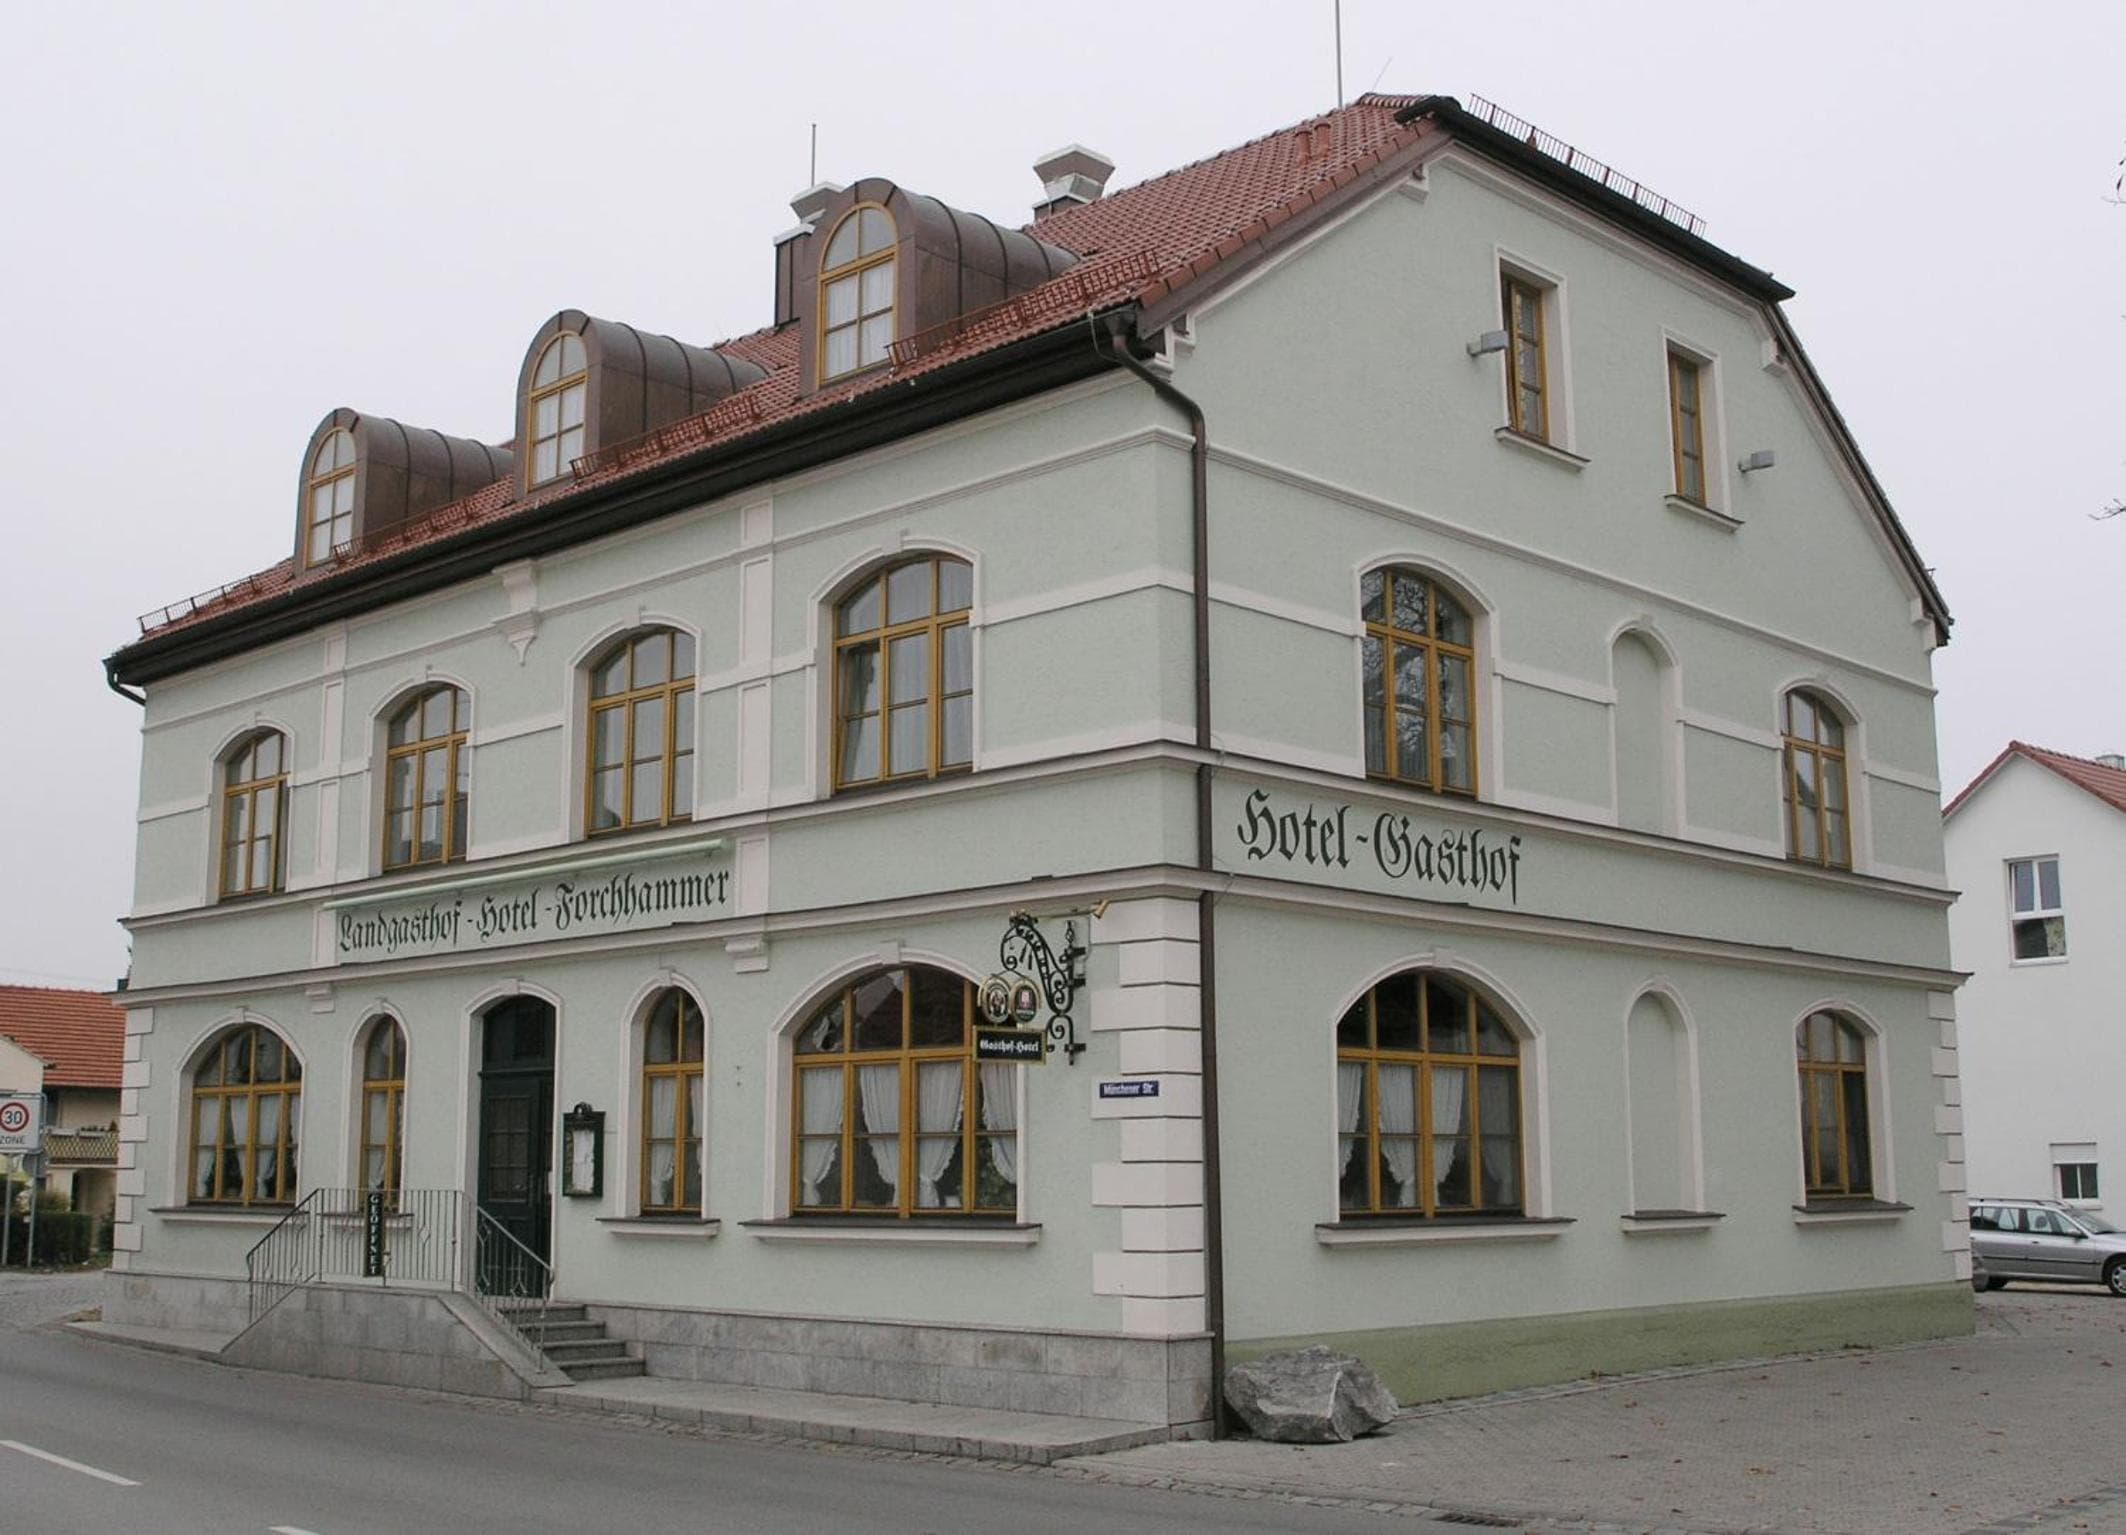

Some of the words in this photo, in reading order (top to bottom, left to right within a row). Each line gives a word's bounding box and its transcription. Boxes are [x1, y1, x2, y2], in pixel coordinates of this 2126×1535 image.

[340, 900, 462, 953] Landgasthof
[555, 869, 730, 930] Forchhammer
[4, 1110, 22, 1124] 30
[0, 1135, 26, 1145] ZONE
